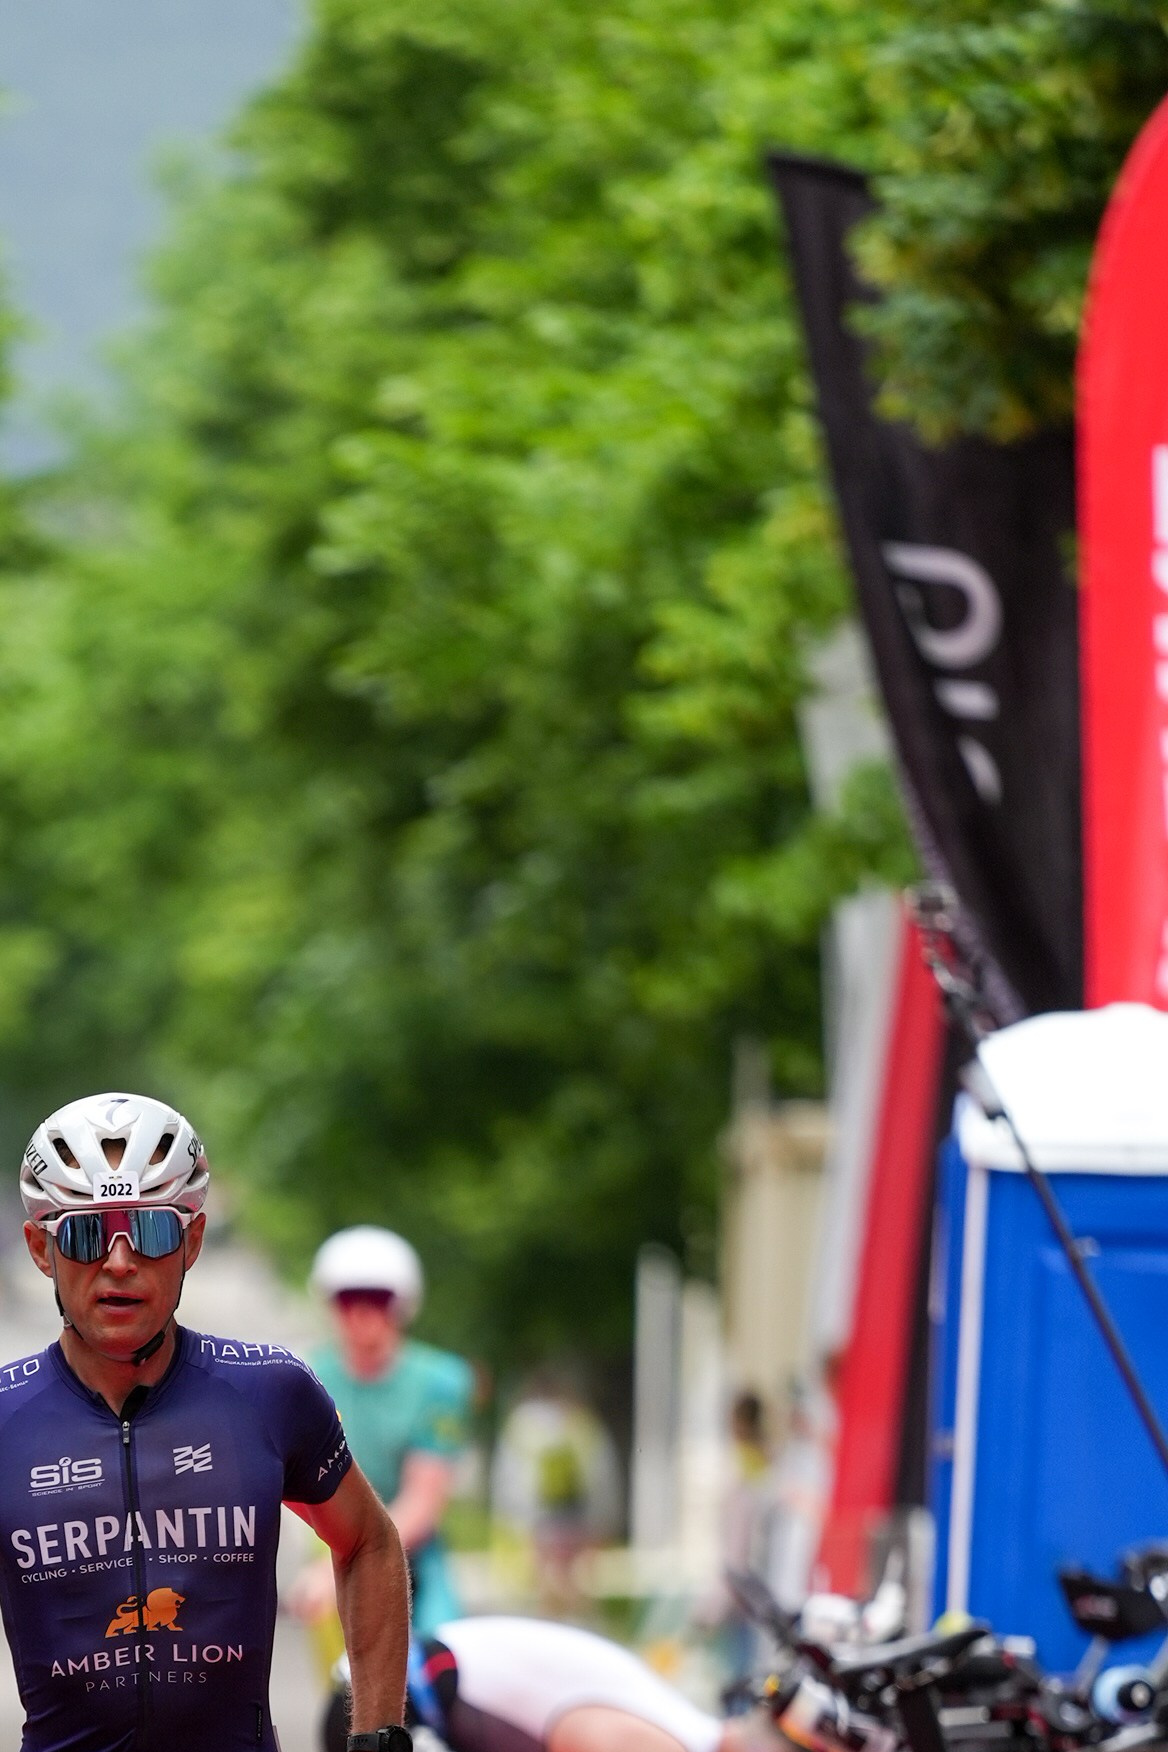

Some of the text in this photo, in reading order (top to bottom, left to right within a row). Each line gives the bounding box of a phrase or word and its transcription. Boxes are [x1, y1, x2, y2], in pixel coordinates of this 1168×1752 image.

[101, 1183, 133, 1197] 2022
[32, 1489, 63, 1497] SCIENCE
[77, 1482, 103, 1490] SPORT
[10, 1505, 256, 1569] SERPANTIN
[21, 1552, 255, 1584] CYCLING SERVICE SHOP COFFEE
[51, 1643, 243, 1678] AMBER LION
[85, 1670, 208, 1693] PARTNERS
